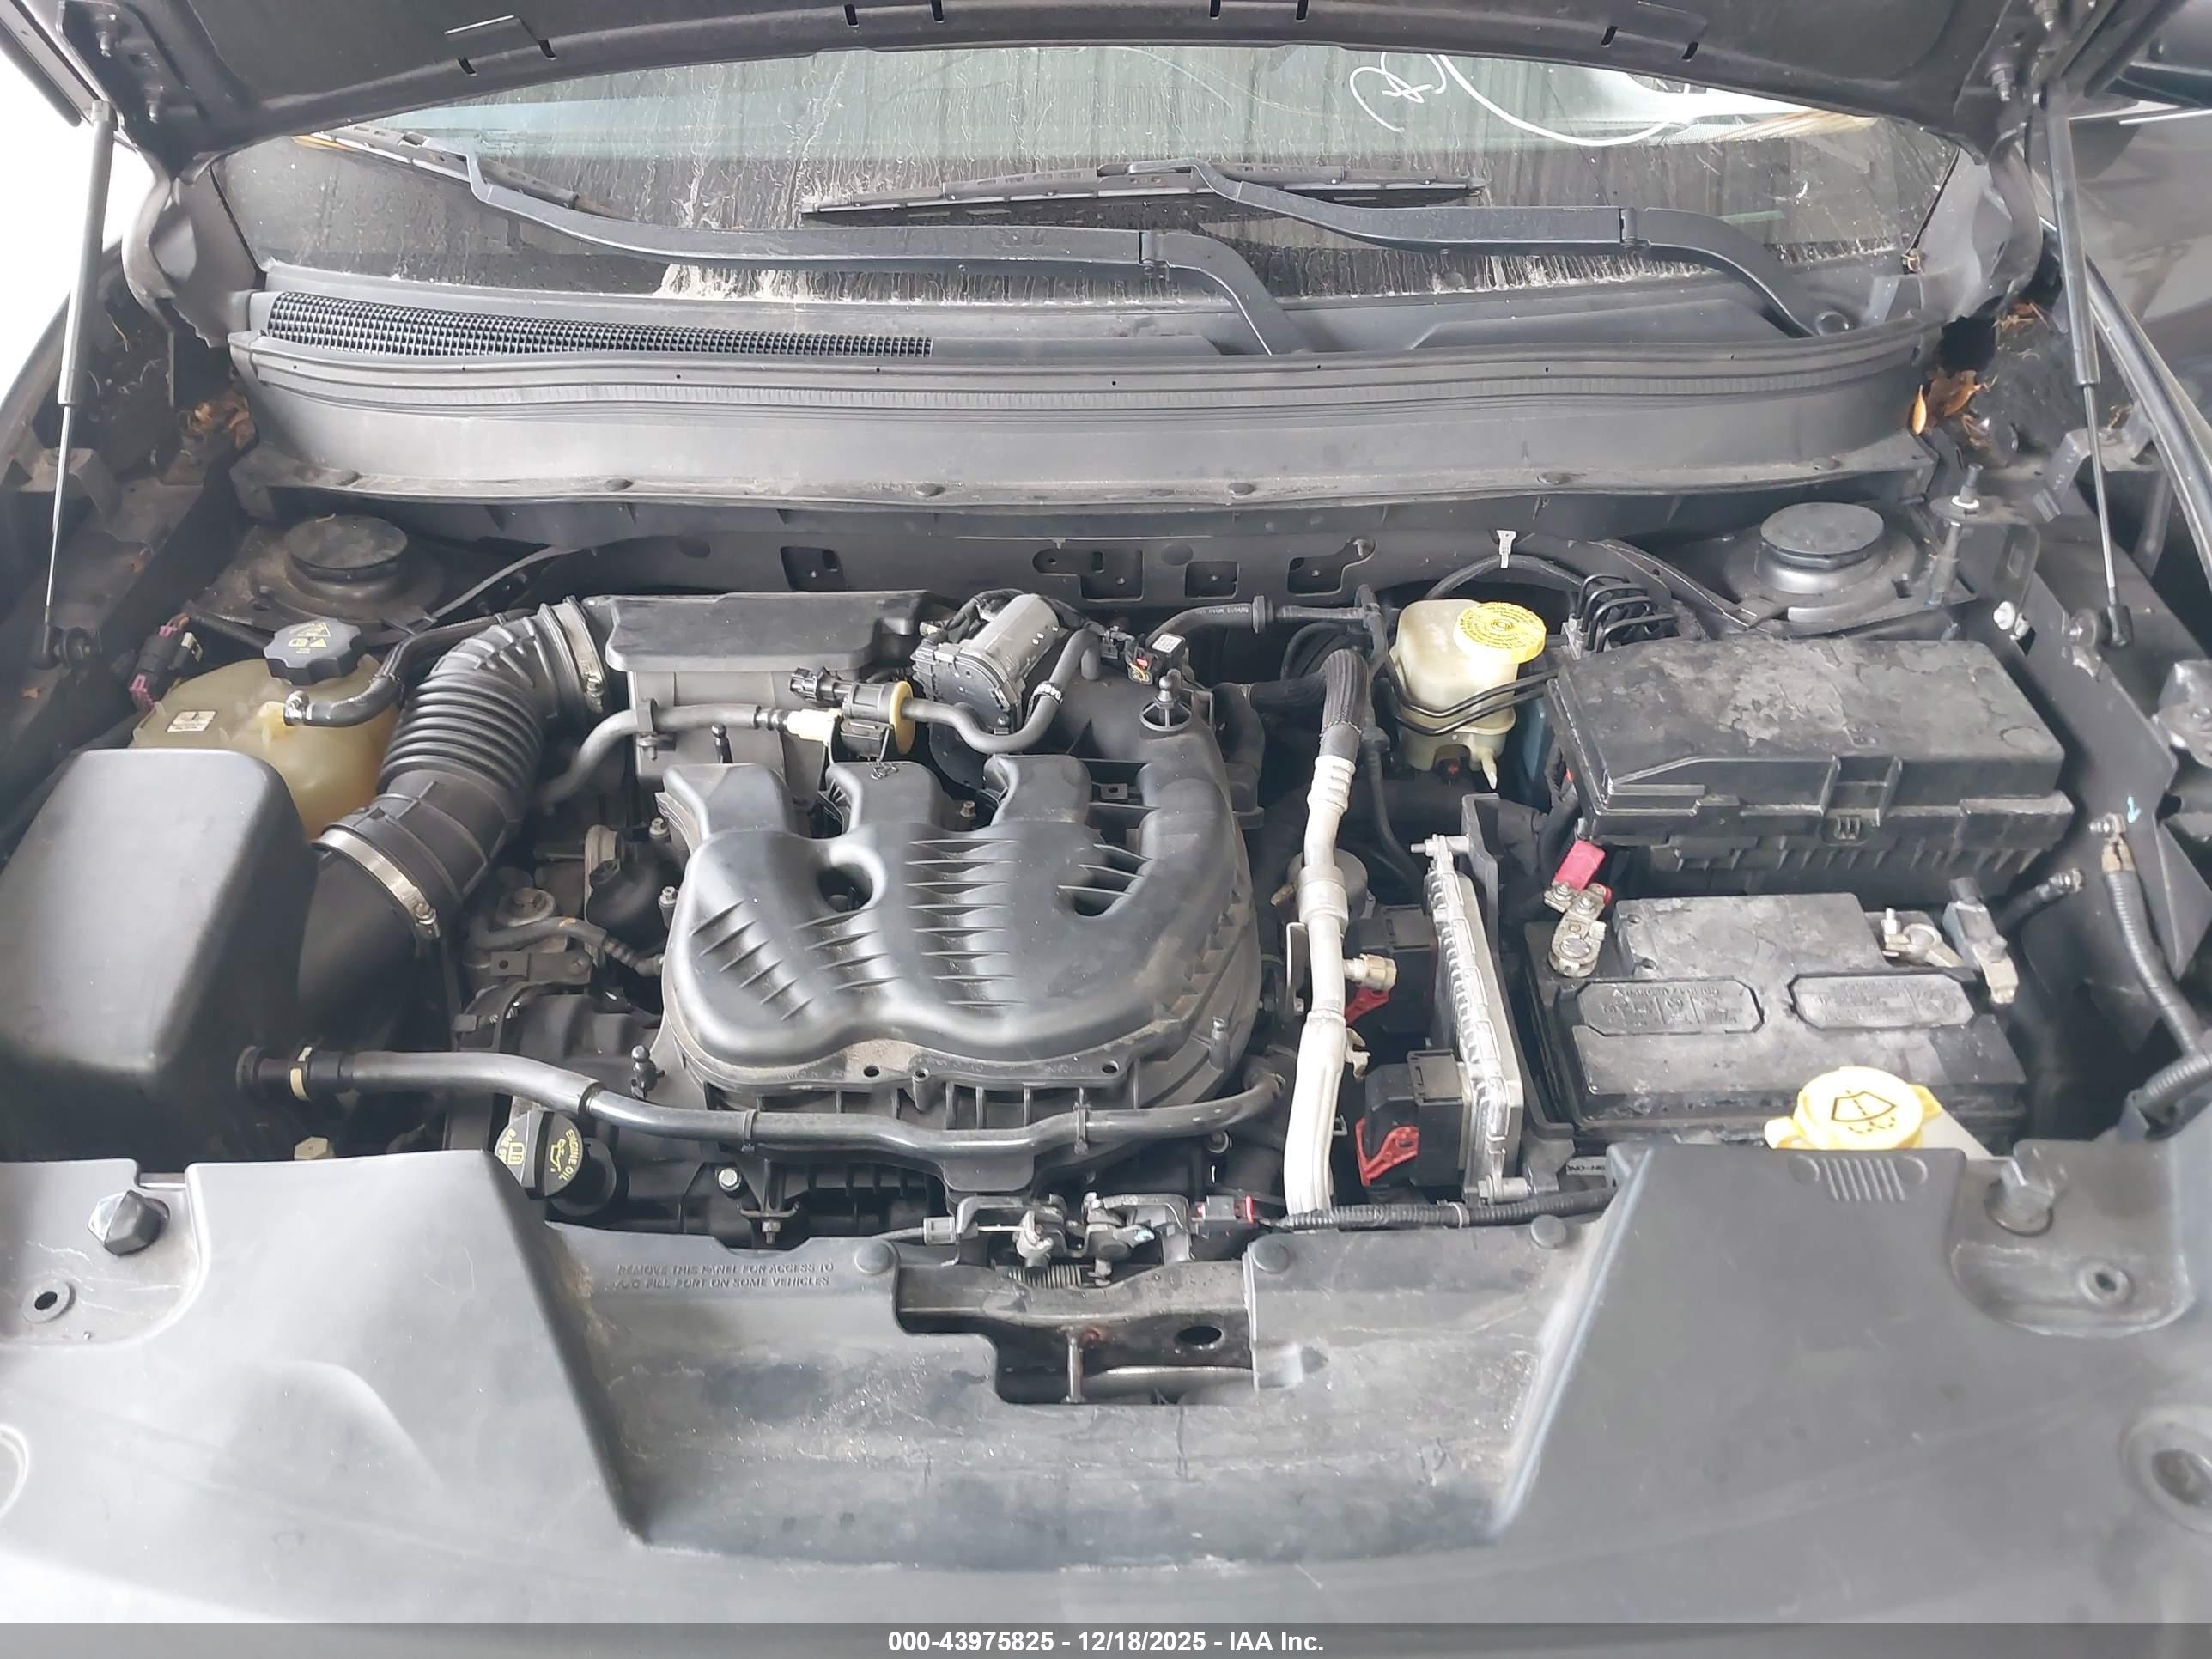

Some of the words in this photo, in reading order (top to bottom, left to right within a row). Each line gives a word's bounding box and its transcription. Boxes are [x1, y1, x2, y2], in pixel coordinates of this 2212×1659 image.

[565, 1128, 580, 1165] ENGINE
[558, 1164, 574, 1182] OIL
[617, 1263, 667, 1275] REMOVE
[672, 1263, 699, 1275] THIS
[700, 1263, 738, 1275] PANEL
[741, 1263, 767, 1274] FOR
[769, 1262, 816, 1274] ACCESS
[818, 1261, 835, 1273] TO
[642, 1276, 670, 1288] FILL
[672, 1276, 705, 1288] PORT
[709, 1276, 729, 1288] ON
[732, 1276, 767, 1288] SOME
[770, 1275, 830, 1287] VEHICLES
